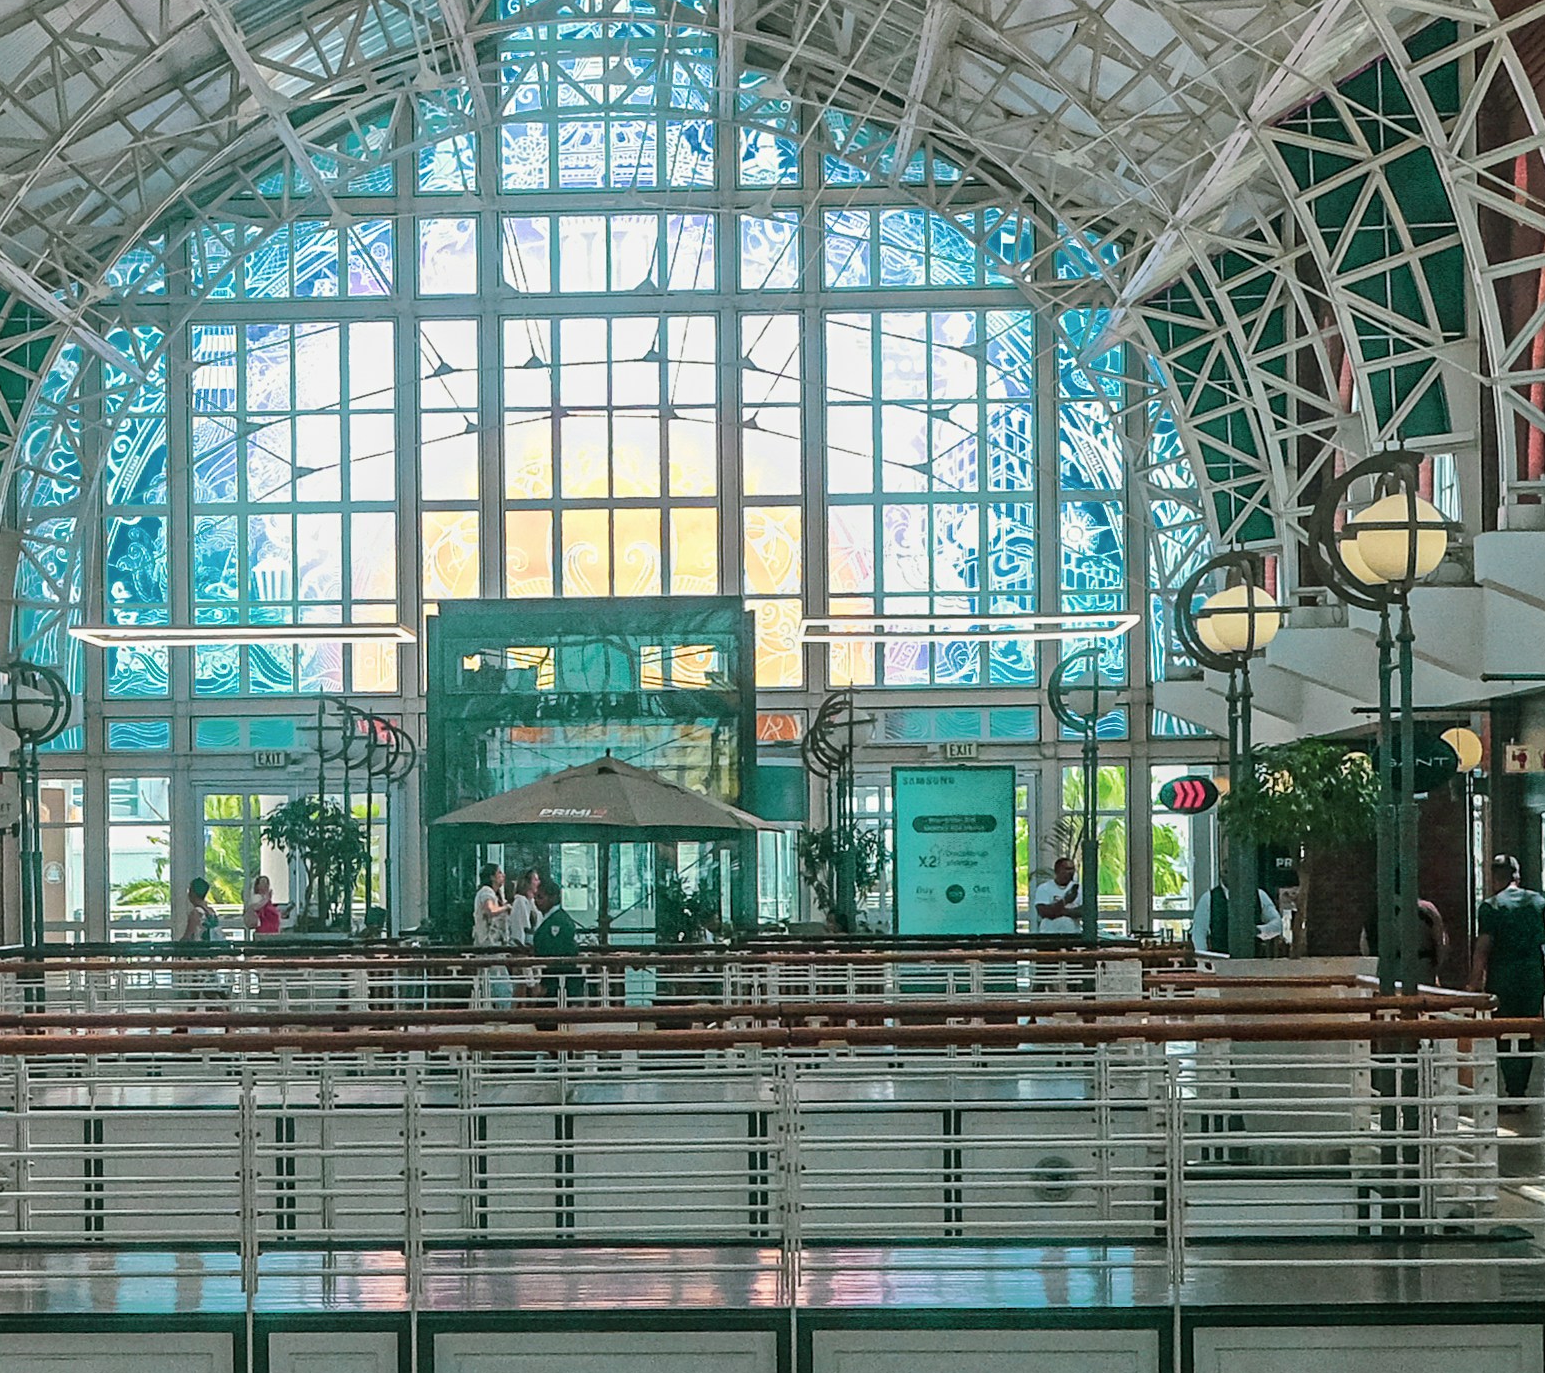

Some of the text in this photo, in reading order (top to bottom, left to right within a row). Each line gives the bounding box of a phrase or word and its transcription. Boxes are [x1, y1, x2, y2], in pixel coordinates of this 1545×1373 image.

[949, 744, 973, 756] EXIT
[258, 752, 282, 765] EXIT
[901, 776, 956, 785] SAMSUNG
[539, 808, 592, 817] PRIMI
